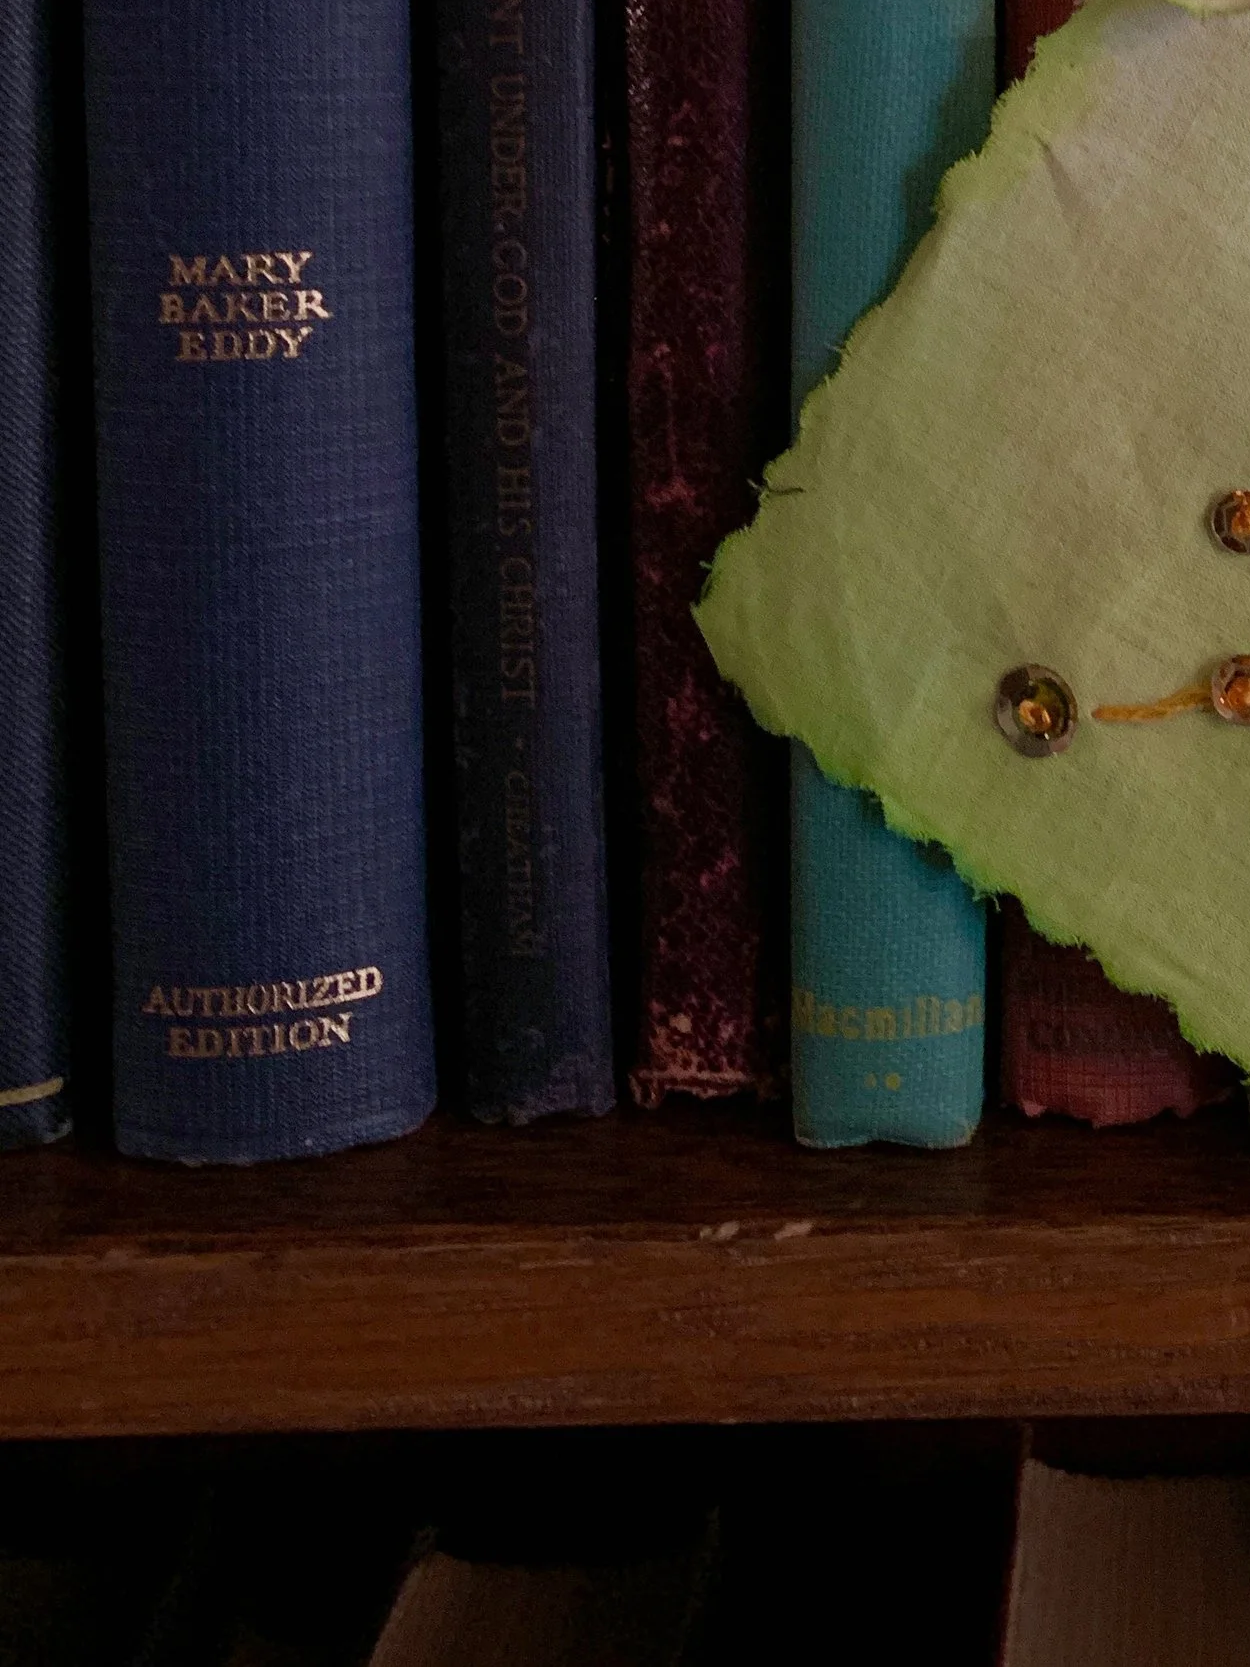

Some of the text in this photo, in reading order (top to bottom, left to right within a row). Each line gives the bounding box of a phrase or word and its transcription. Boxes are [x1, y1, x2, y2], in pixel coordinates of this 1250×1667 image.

[490, 73, 528, 216] UNDER
[169, 251, 314, 287] MARY
[494, 239, 528, 335] GOD
[159, 289, 335, 325] BAKER
[175, 326, 314, 363] EDDY
[497, 354, 531, 445] AND
[498, 466, 533, 538] HIS
[500, 555, 538, 709] CHRIST
[138, 966, 386, 1018] AUTHORIZED
[166, 1010, 354, 1059] EDITION
